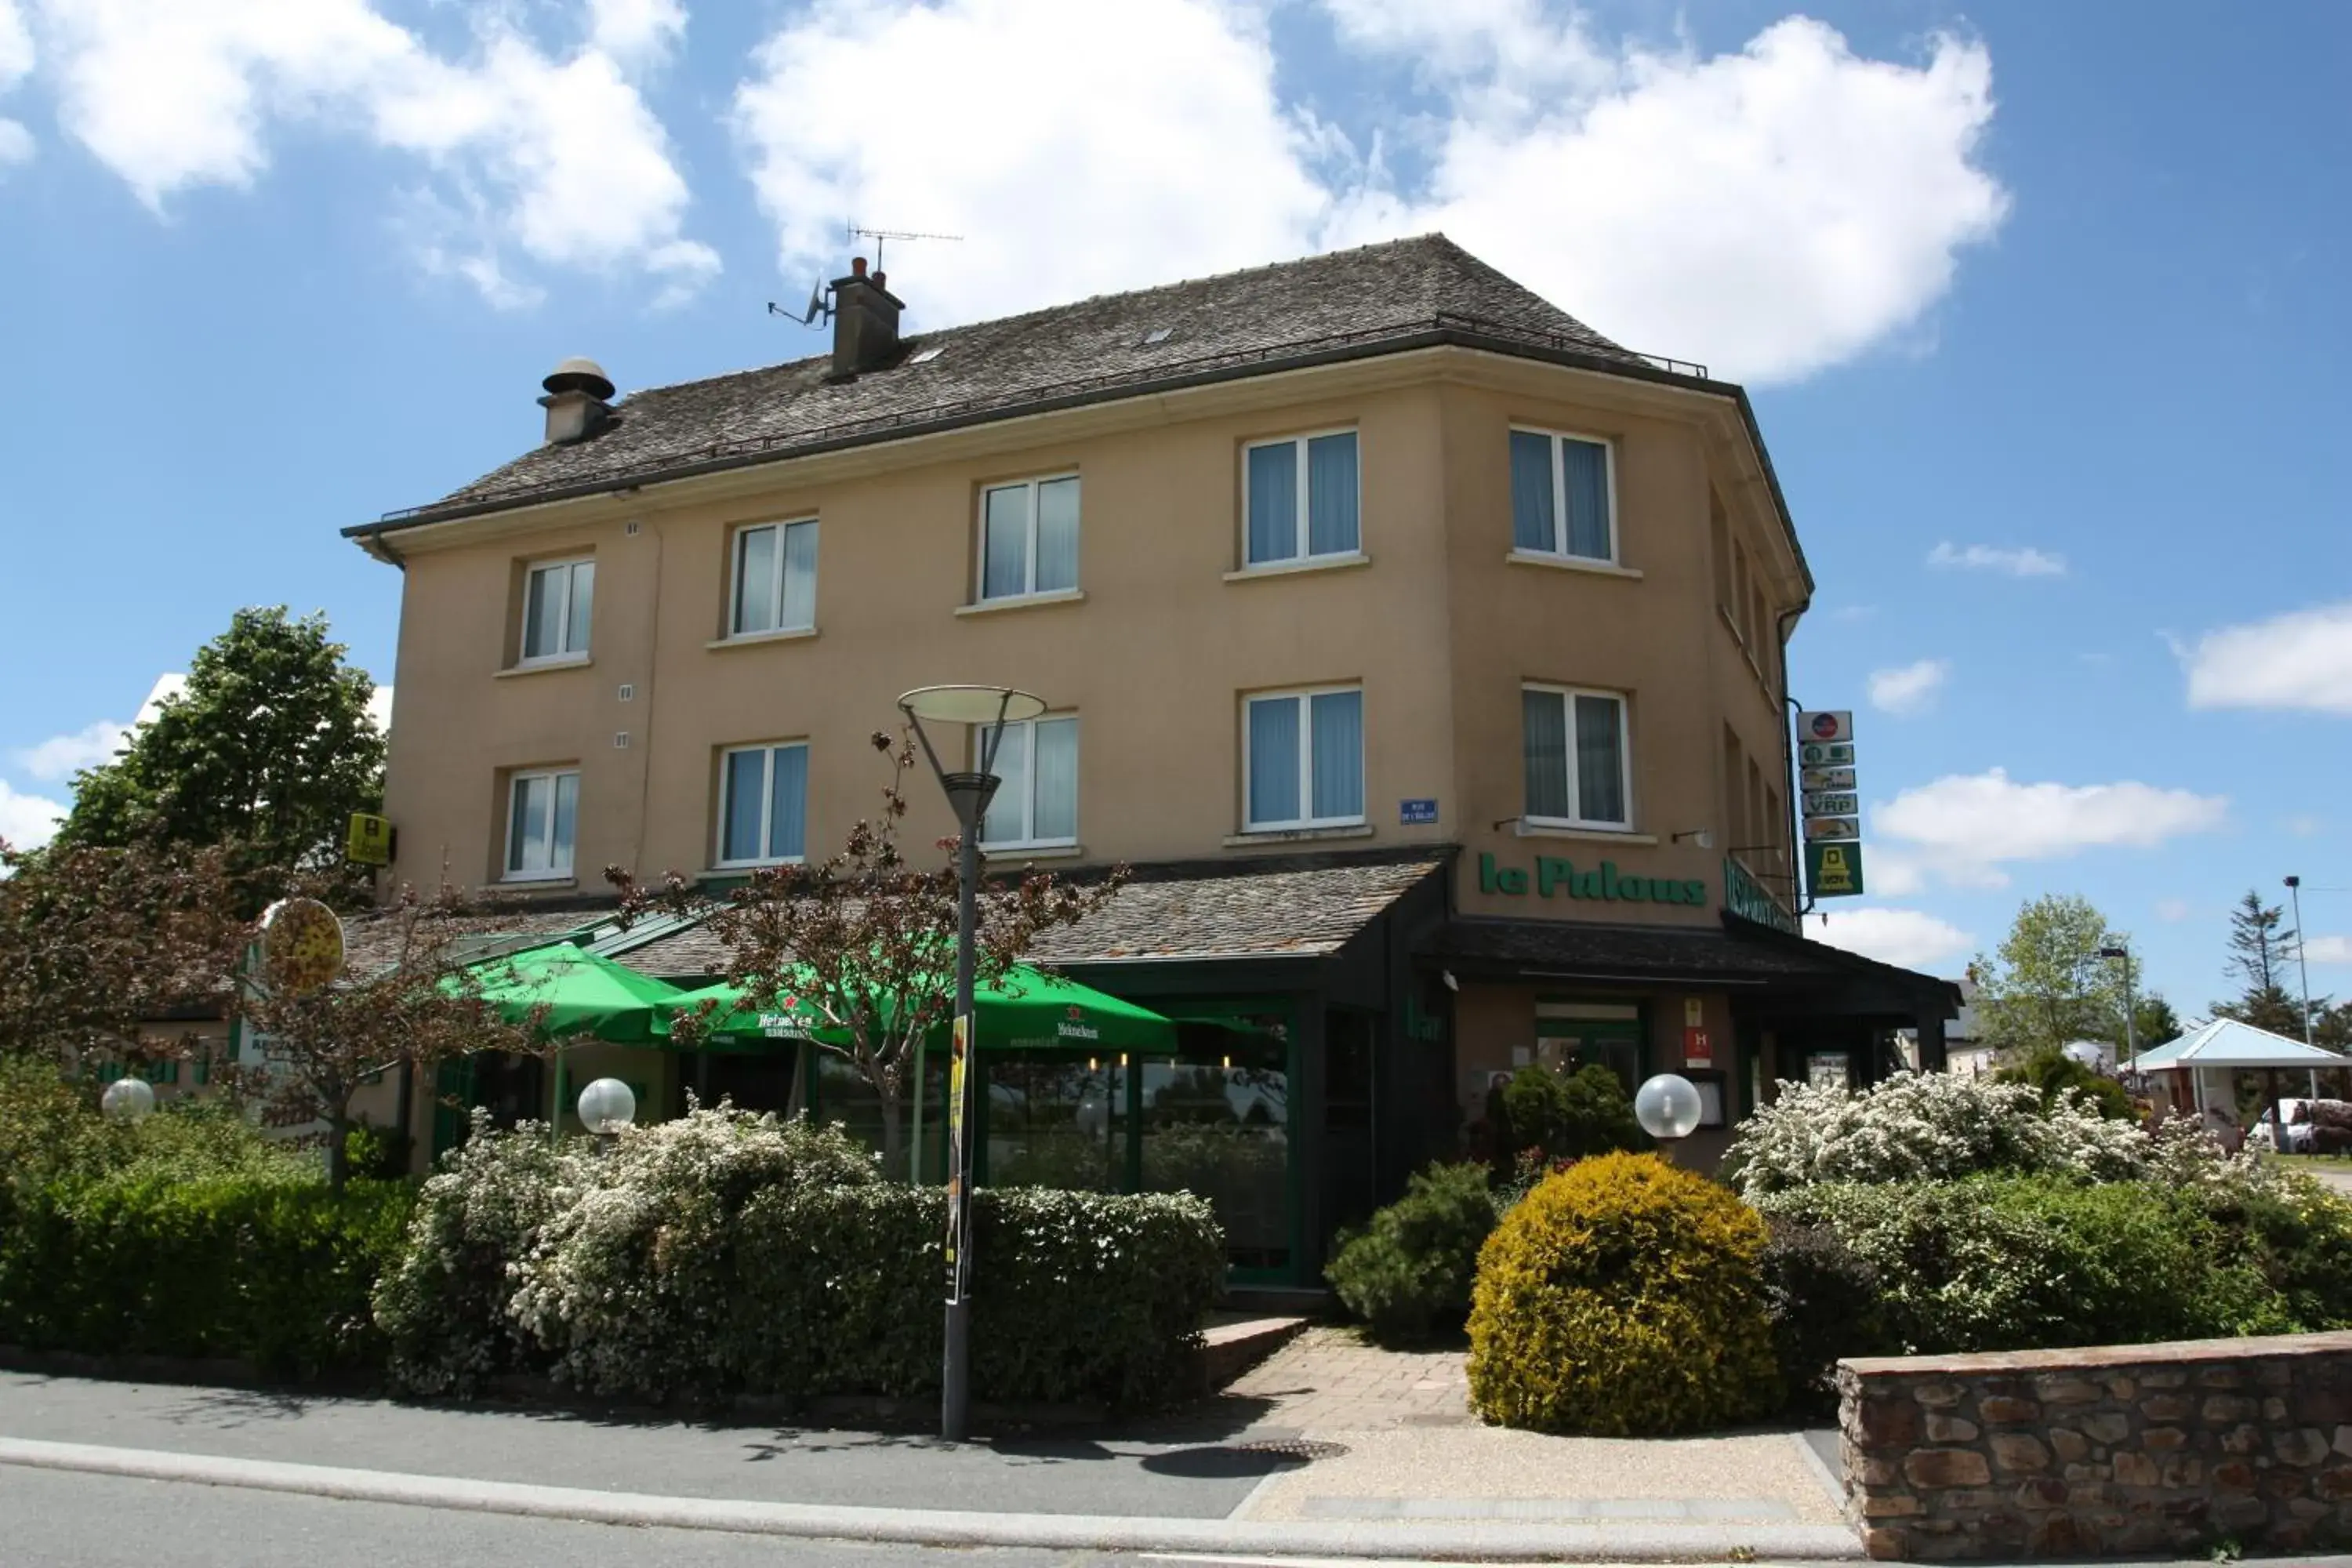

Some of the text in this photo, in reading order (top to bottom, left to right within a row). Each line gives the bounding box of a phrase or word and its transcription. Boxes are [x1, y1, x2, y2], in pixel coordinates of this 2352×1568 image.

[1810, 800, 1851, 812] VRP
[1535, 855, 1708, 908] Palous
[1695, 1033, 1708, 1047] H
